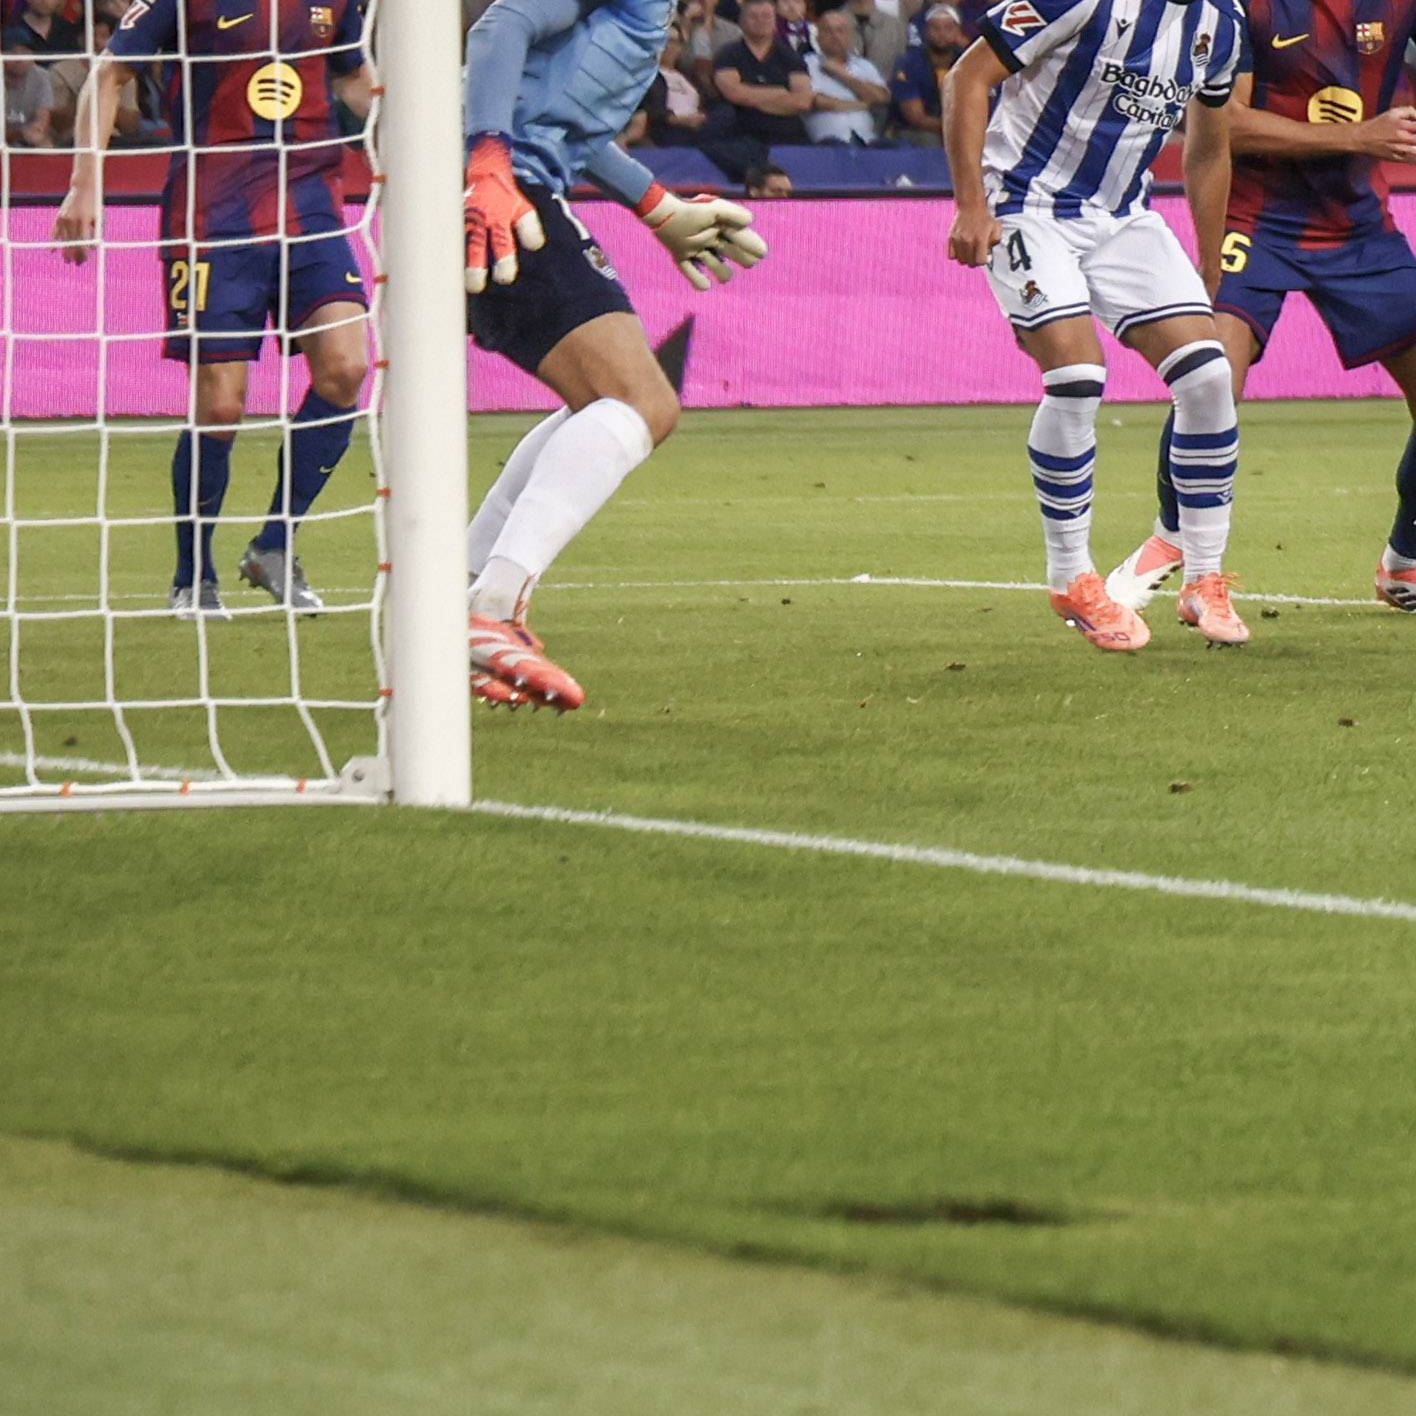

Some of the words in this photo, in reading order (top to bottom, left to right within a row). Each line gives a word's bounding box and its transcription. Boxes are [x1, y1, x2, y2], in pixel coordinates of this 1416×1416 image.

[1007, 229, 1032, 272] 4
[1220, 232, 1252, 273] 5
[170, 260, 210, 312] 21
